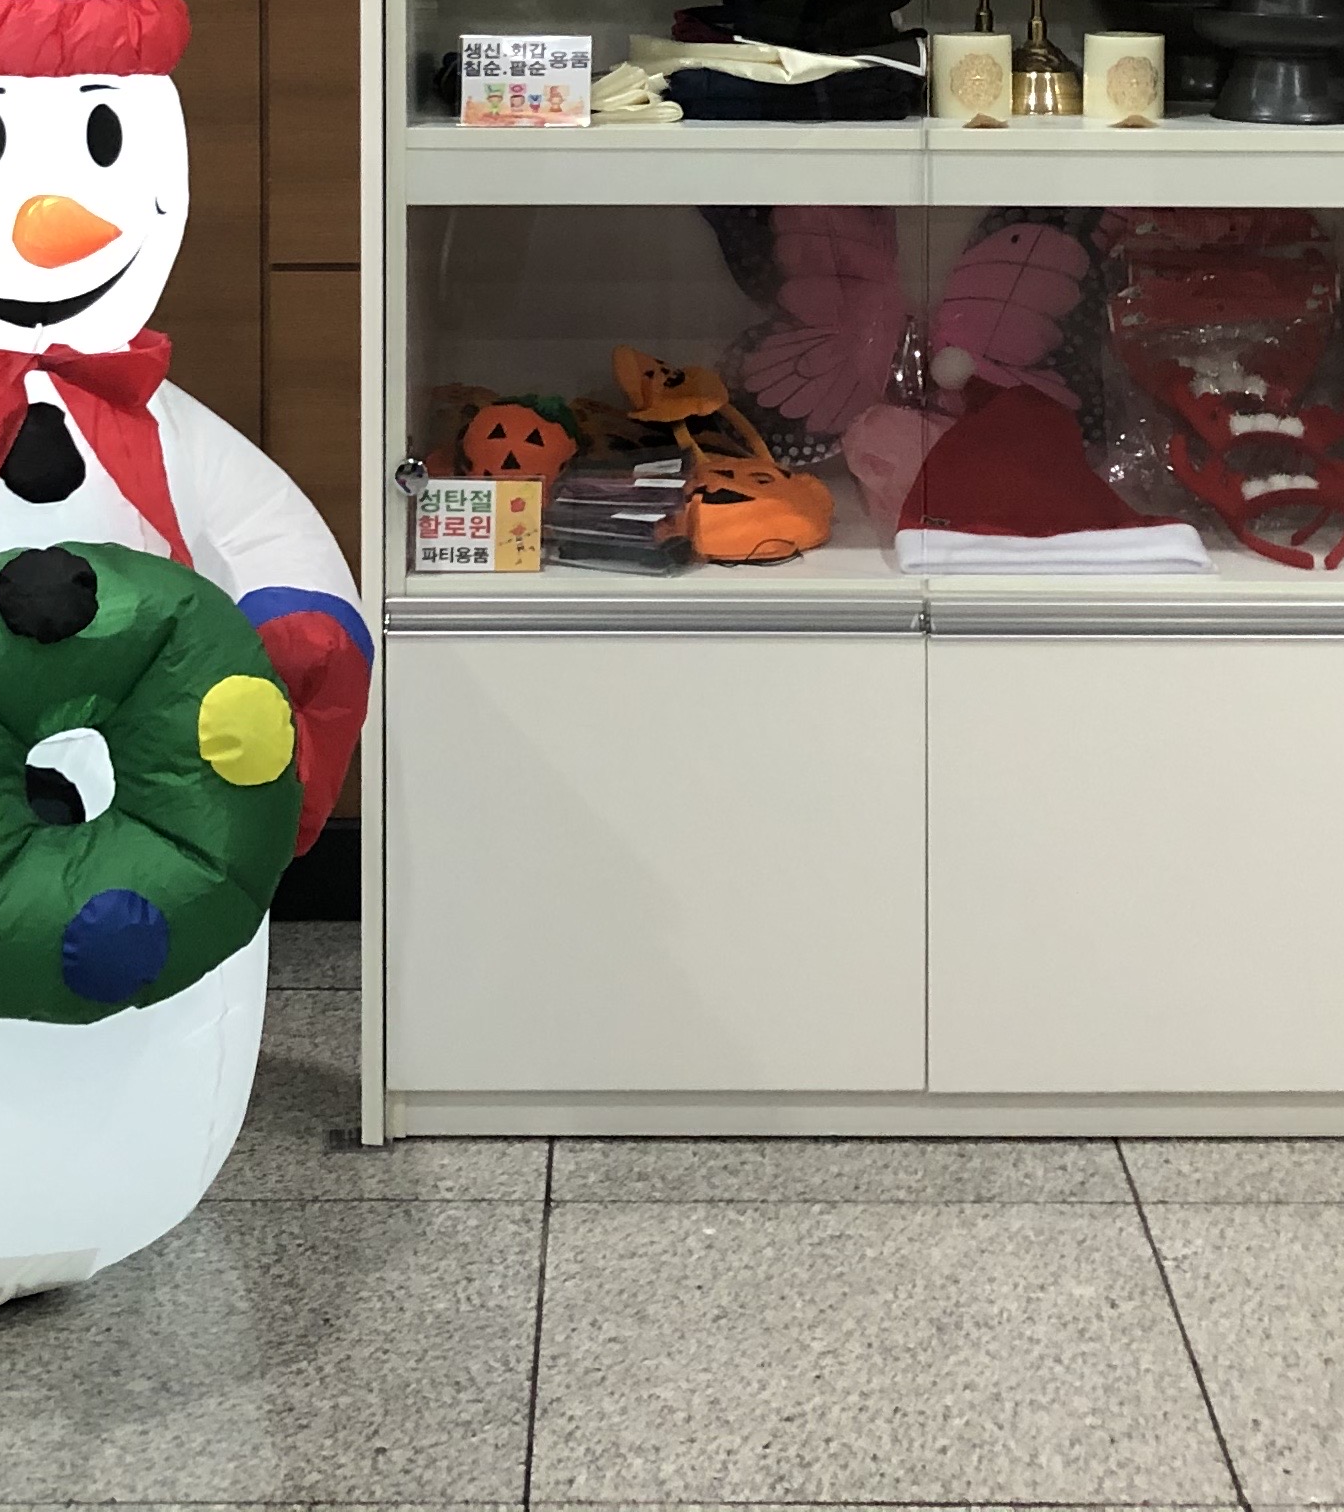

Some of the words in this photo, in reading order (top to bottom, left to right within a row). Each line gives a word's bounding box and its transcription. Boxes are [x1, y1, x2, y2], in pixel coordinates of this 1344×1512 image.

[549, 51, 589, 69] 용품
[419, 489, 492, 513] 성탄절
[419, 515, 491, 539] 할로윈
[421, 546, 489, 564] 파티용품
